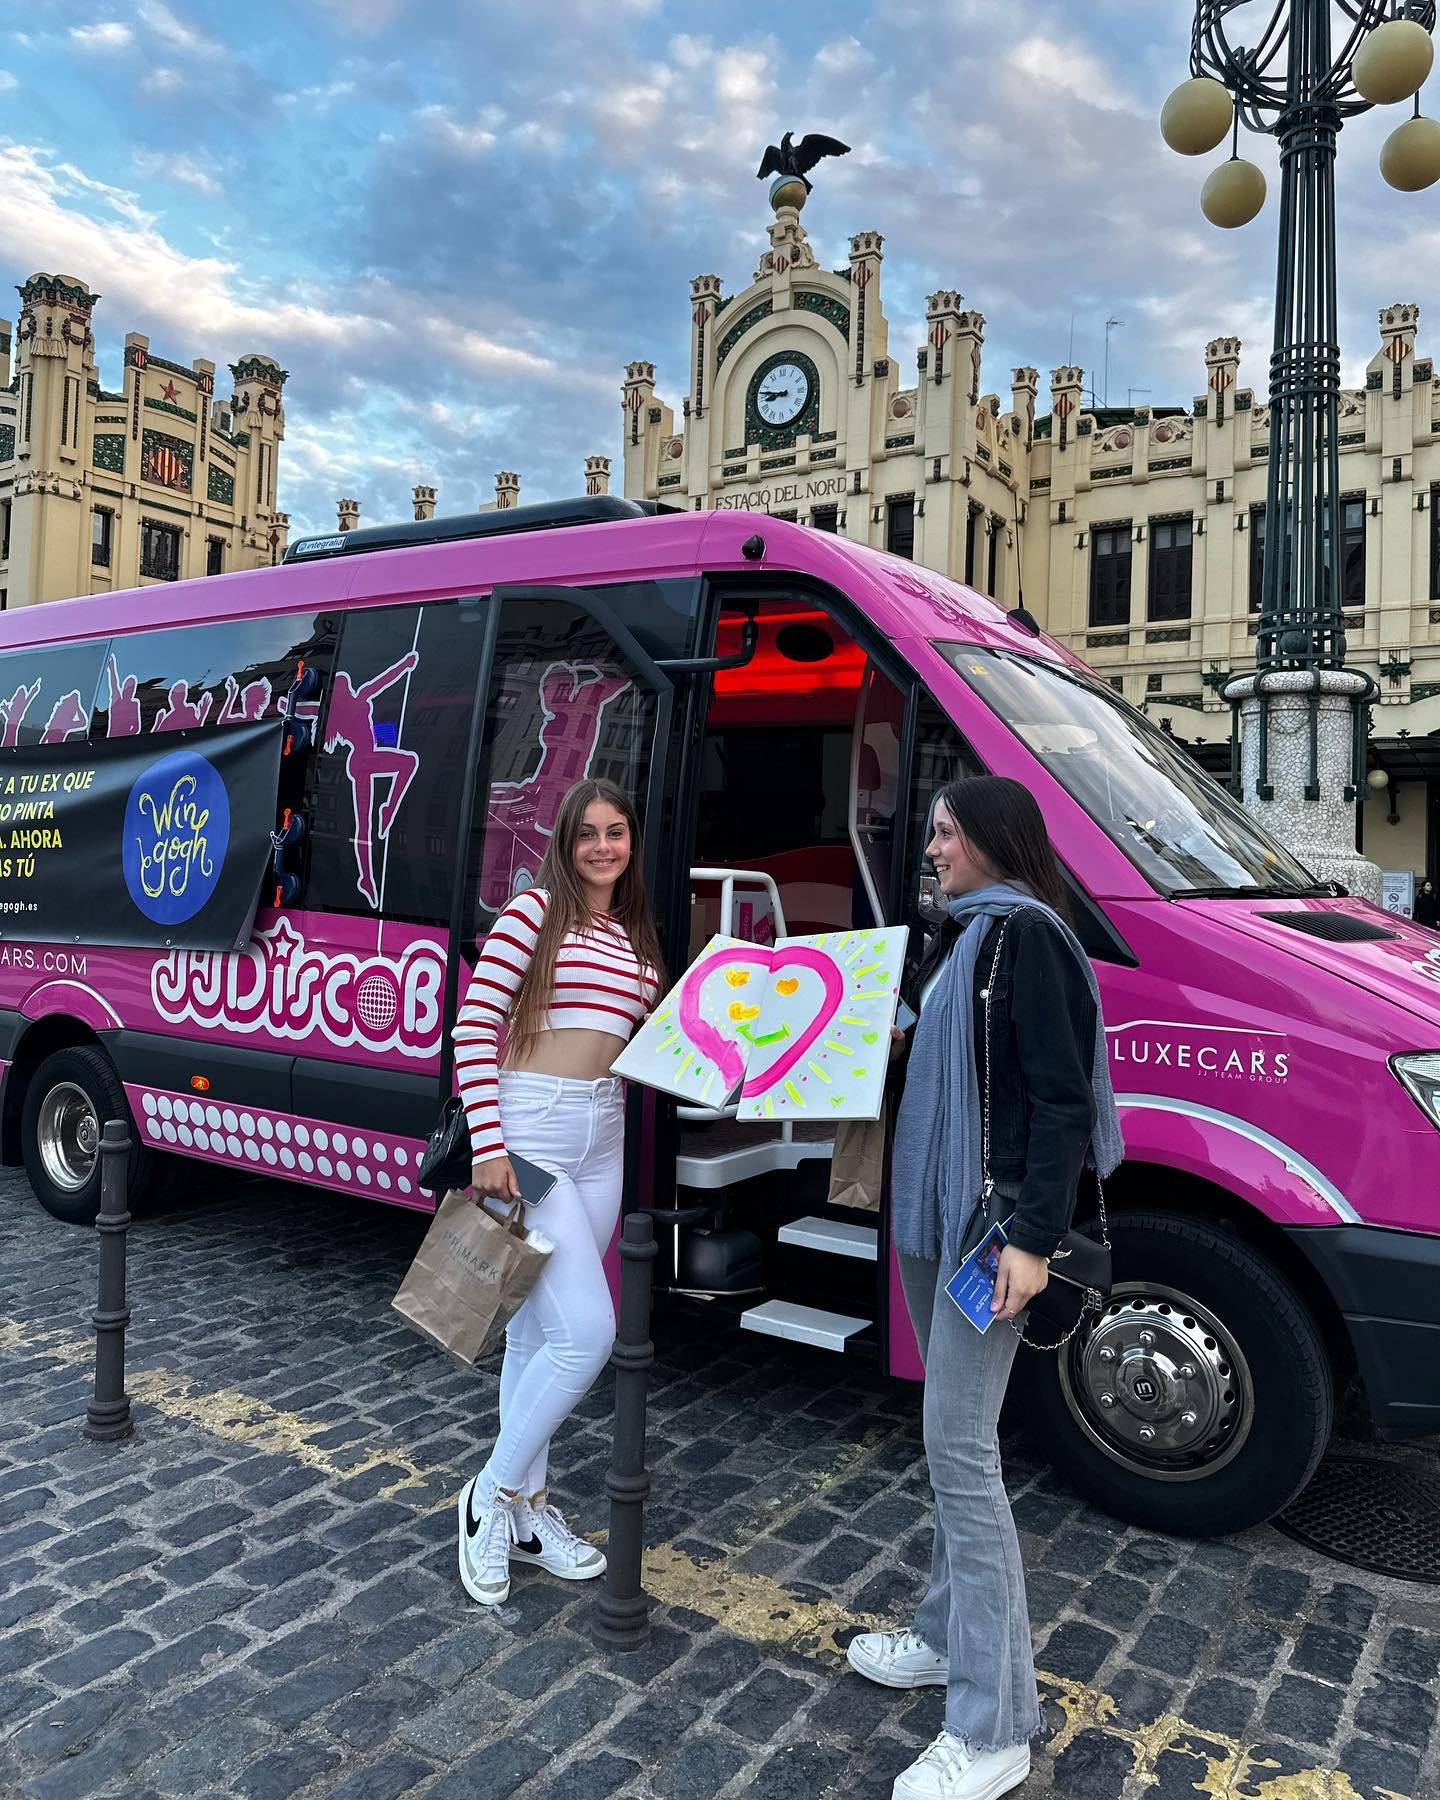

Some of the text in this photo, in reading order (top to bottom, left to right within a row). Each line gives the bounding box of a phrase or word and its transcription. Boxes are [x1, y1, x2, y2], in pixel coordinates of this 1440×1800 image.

[716, 477, 847, 510] ESTACIÓ DEL NORD
[306, 538, 343, 550] integralia
[4, 776, 15, 794] A
[20, 775, 39, 793] TU
[40, 773, 61, 792] EX
[63, 771, 95, 793] QUE
[13, 801, 54, 820] PINTA
[10, 829, 63, 849] AHORA
[17, 852, 35, 878] TÚ
[1114, 1038, 1288, 1077] LUXECARS
[1215, 1071, 1242, 1080] TEAM
[1250, 1075, 1288, 1084] GROUP
[441, 1230, 499, 1281] PRIMARK
